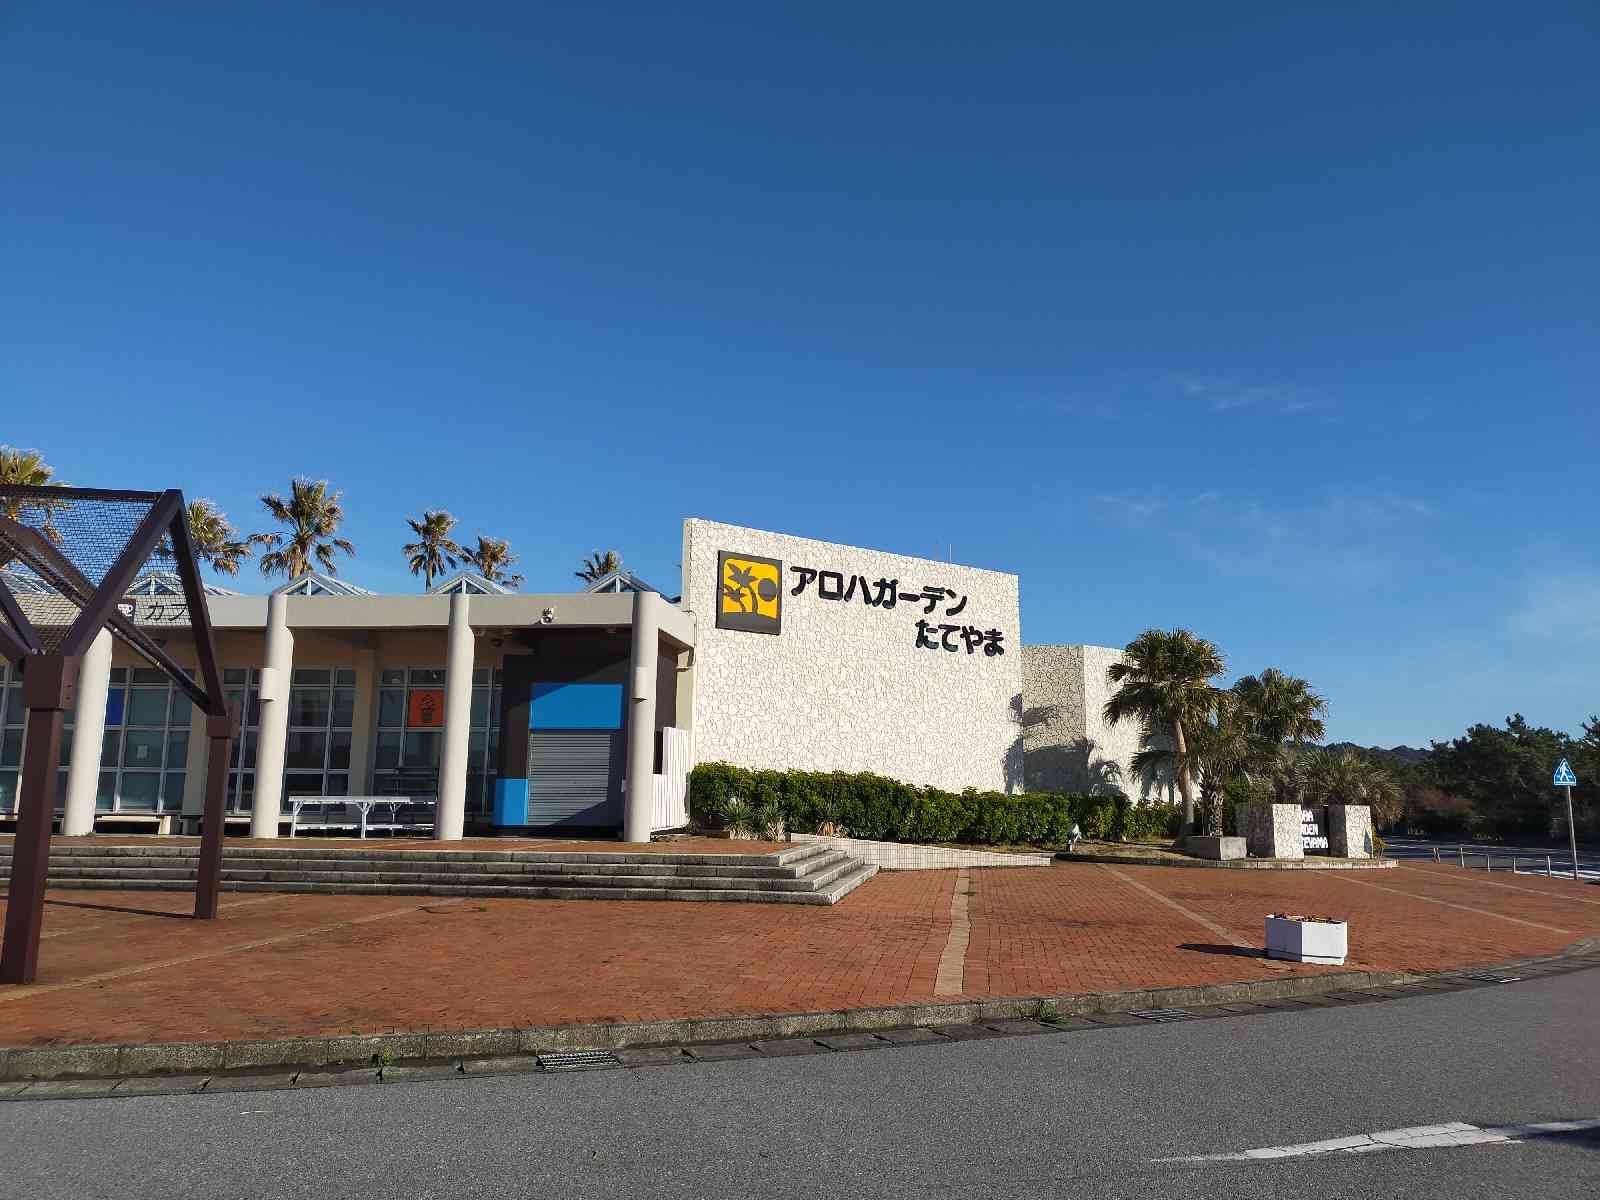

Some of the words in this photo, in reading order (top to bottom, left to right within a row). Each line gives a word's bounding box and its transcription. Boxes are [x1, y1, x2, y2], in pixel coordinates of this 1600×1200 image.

[790, 566, 967, 616] アロハガーデン
[144, 601, 188, 621] カフ
[915, 619, 1004, 657] たてやま
